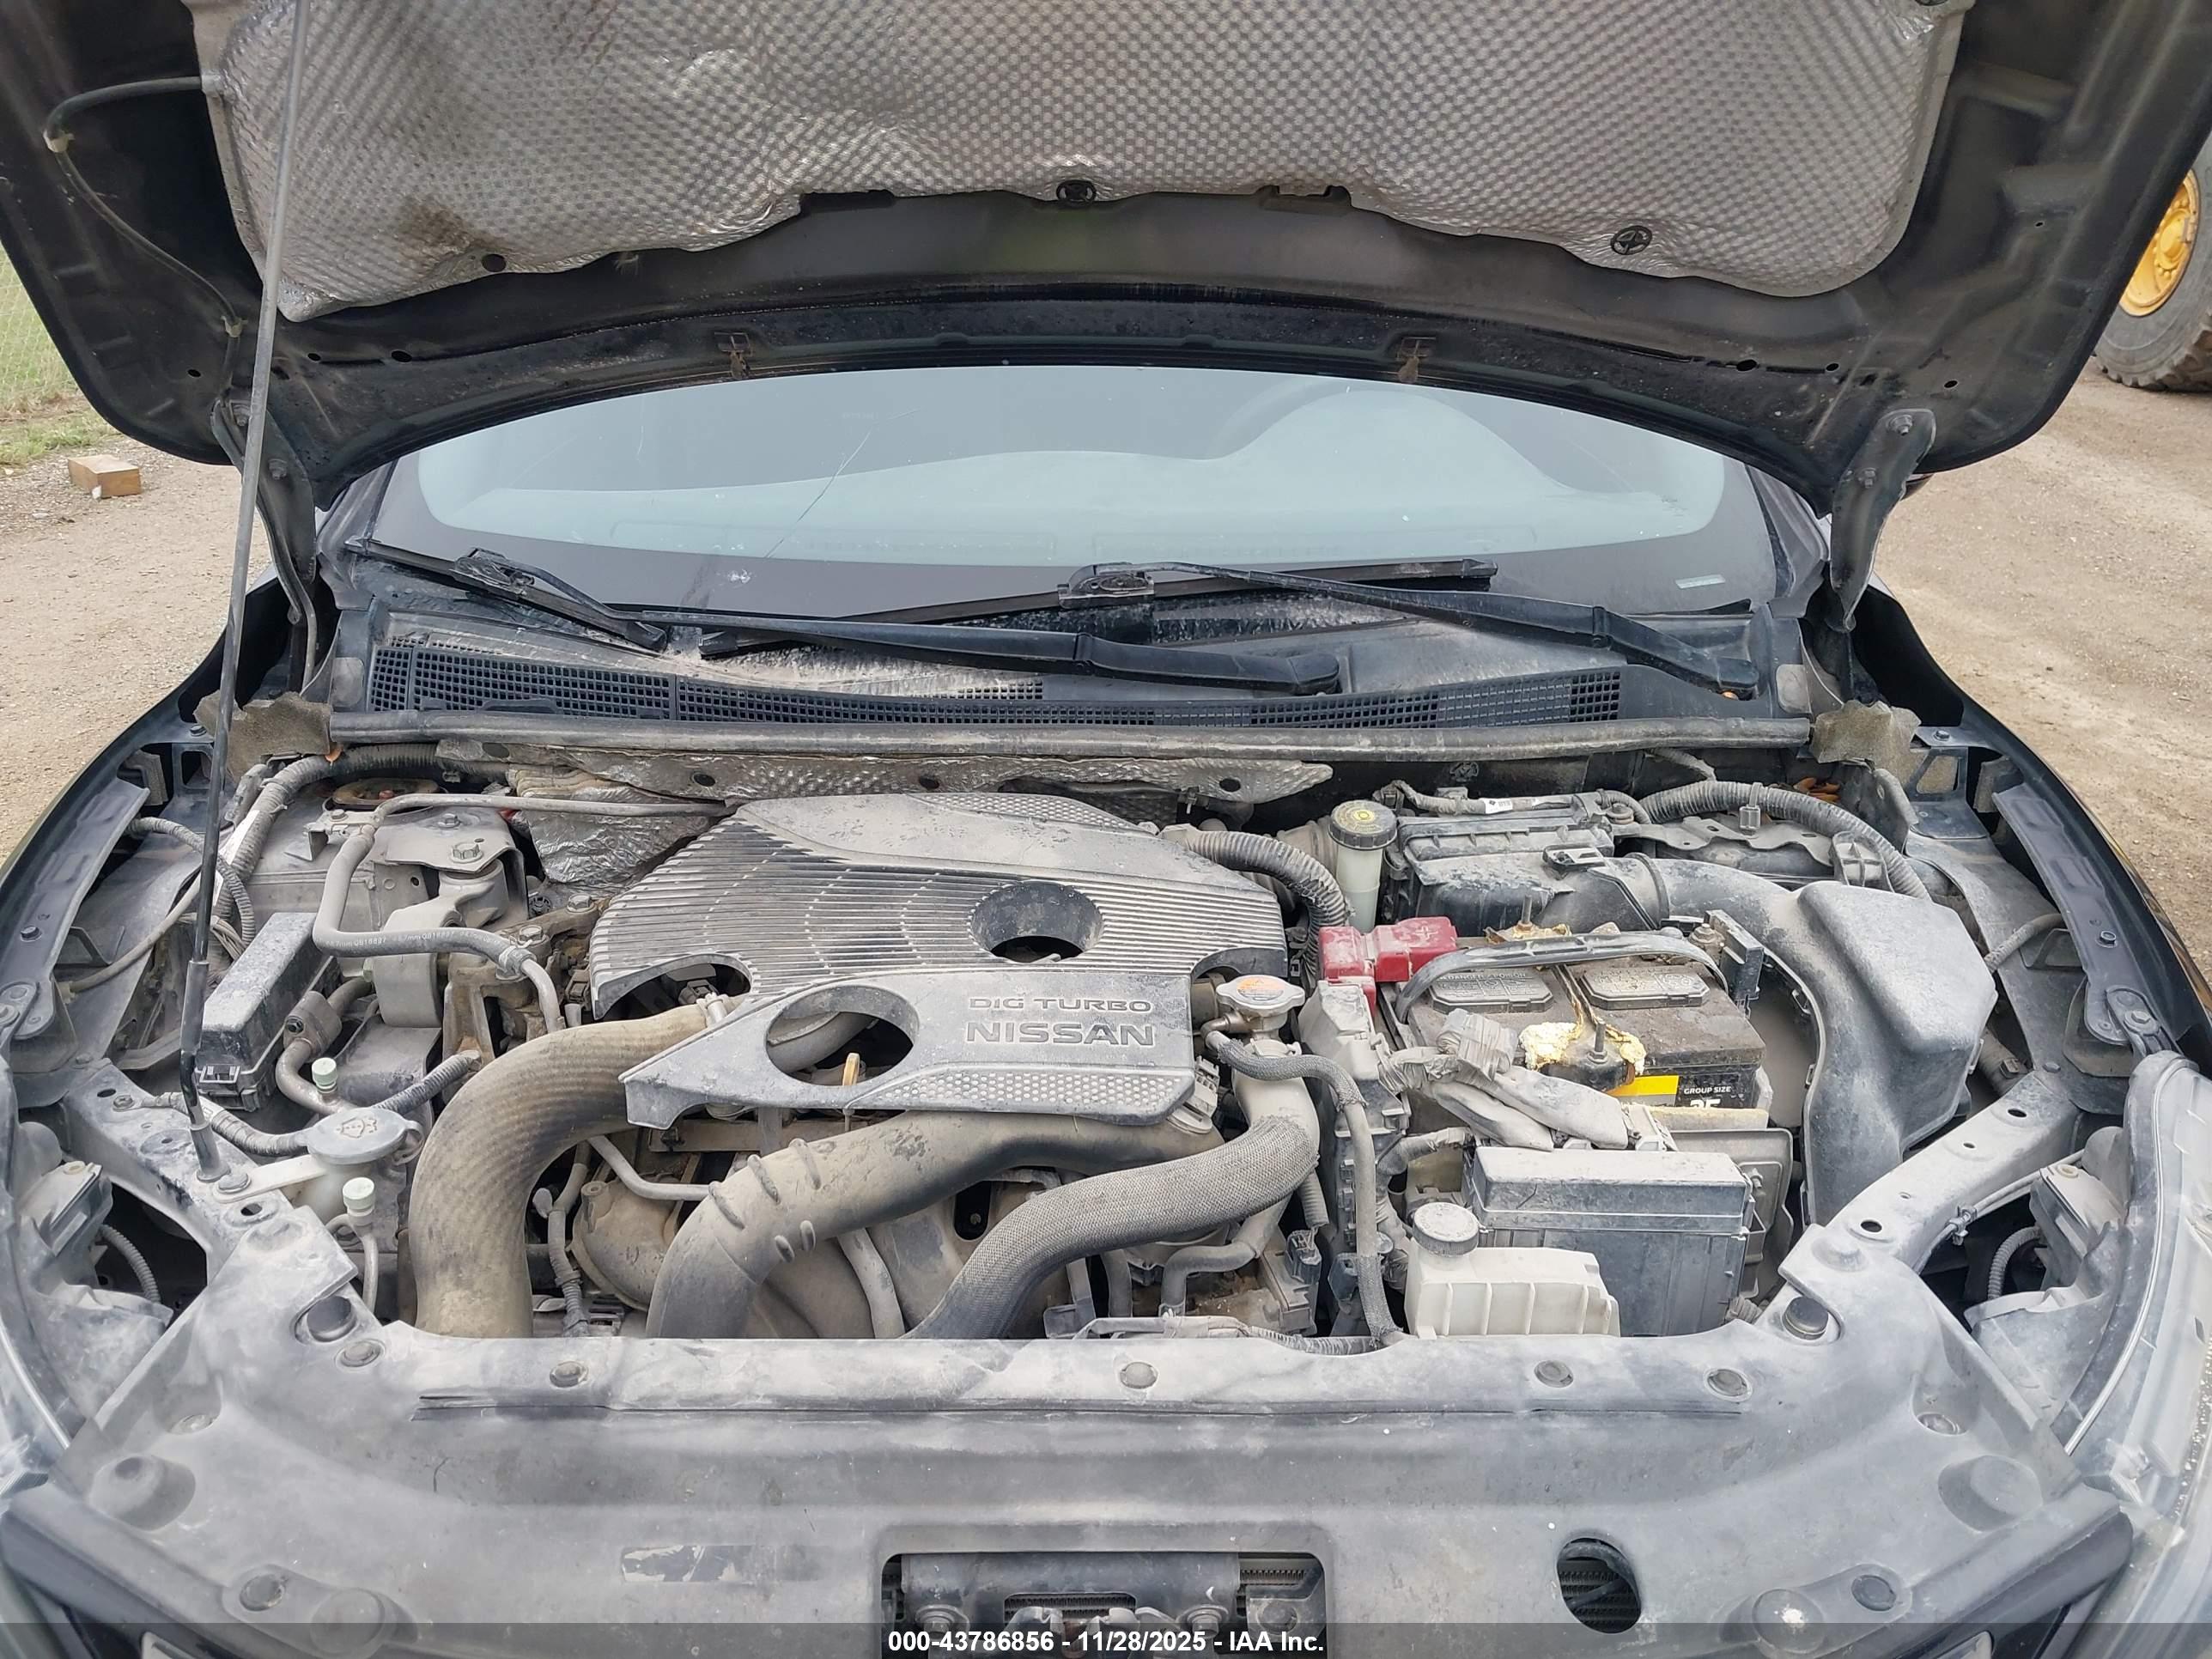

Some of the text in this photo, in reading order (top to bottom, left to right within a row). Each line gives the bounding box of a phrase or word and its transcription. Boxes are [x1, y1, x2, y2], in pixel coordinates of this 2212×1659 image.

[969, 998, 1152, 1012] DIG TURBO
[966, 1022, 1154, 1046] NISSAN
